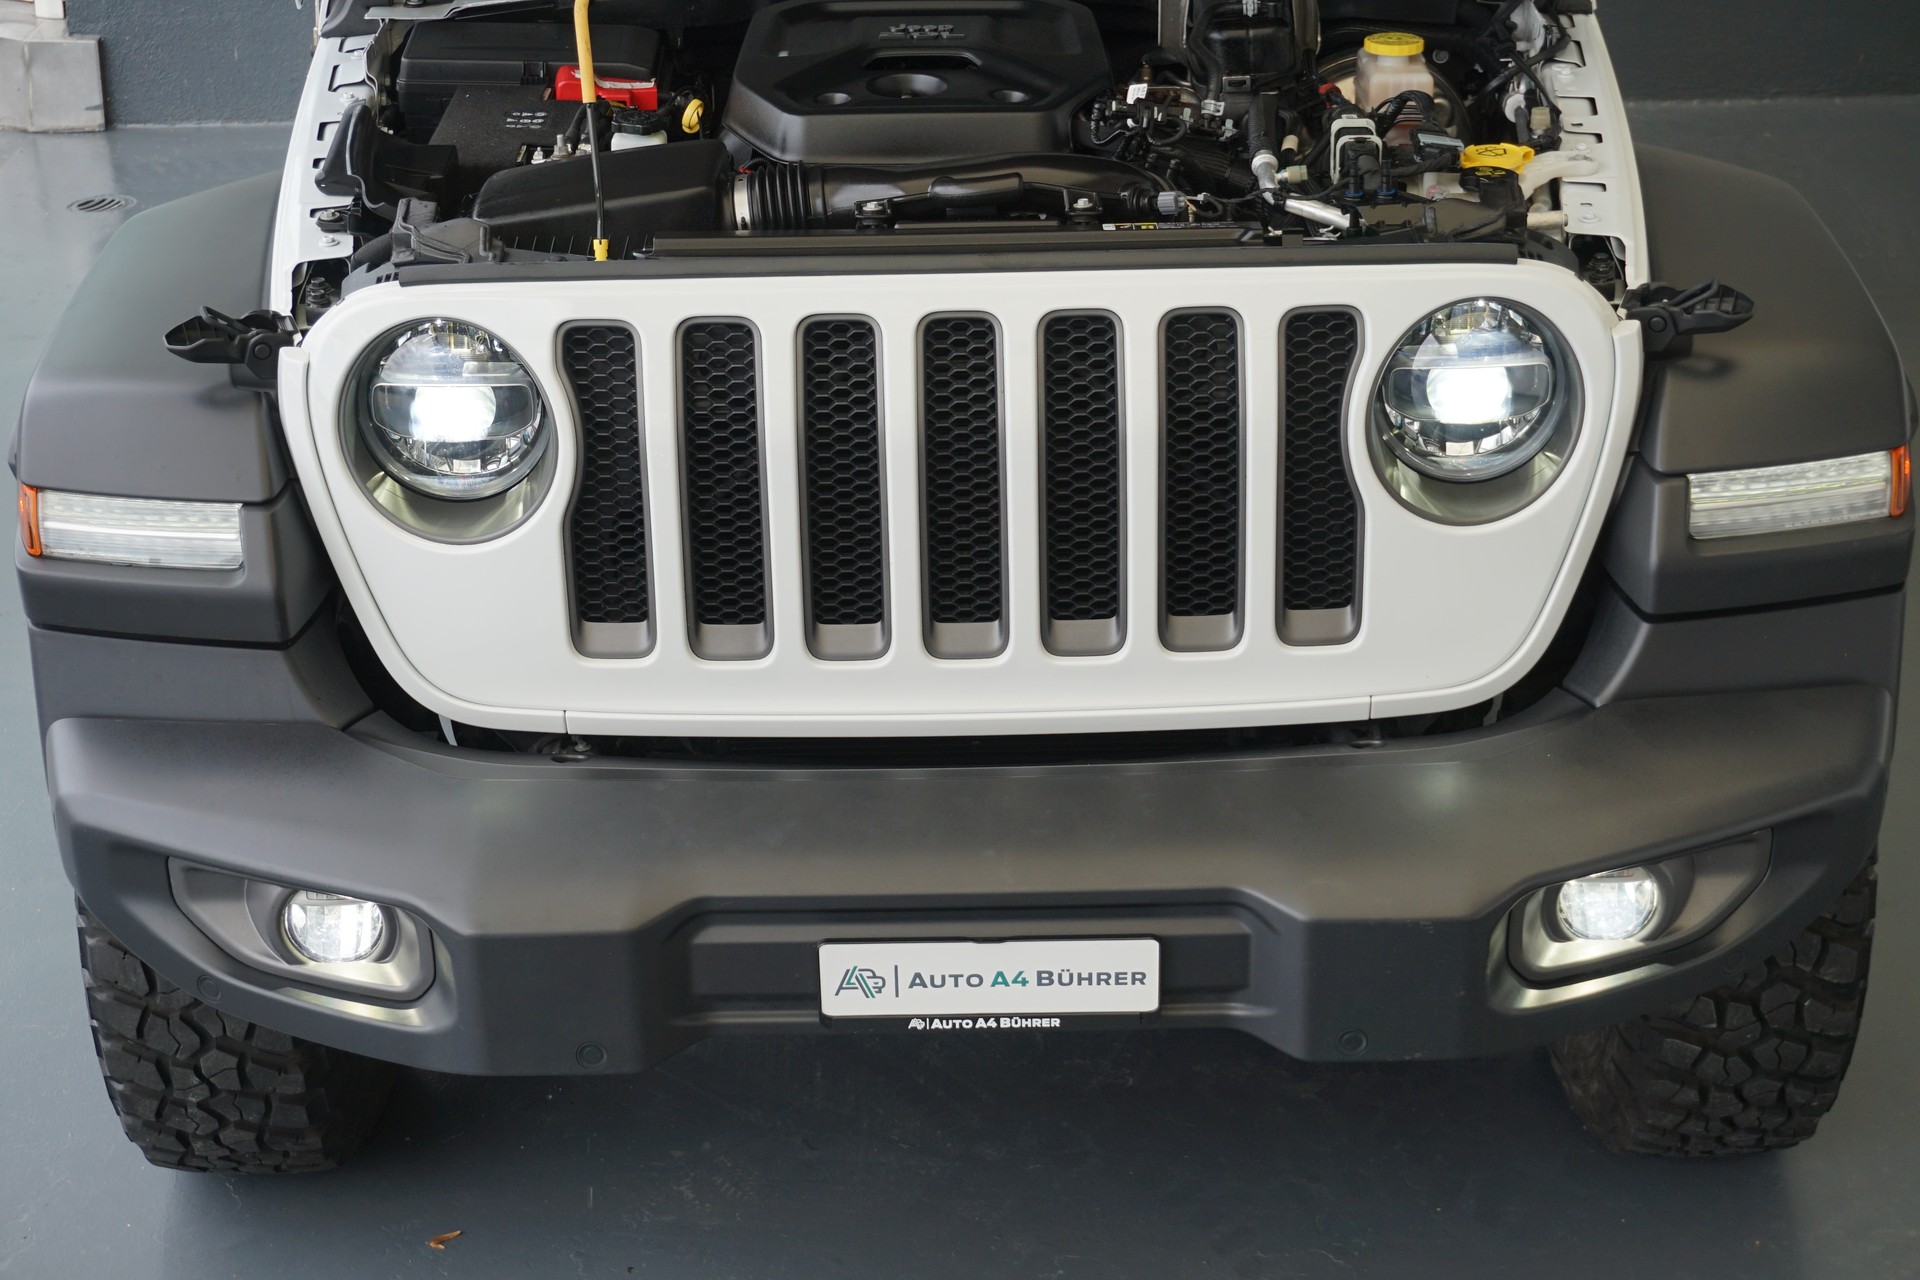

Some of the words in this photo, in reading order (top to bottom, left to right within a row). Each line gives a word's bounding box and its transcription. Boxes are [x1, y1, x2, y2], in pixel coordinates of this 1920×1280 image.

[908, 971, 984, 989] AUTO
[990, 970, 1029, 988] A4
[1036, 968, 1147, 987] BÜHRER
[930, 1018, 973, 1030] AUTO
[975, 1017, 998, 1029] A4
[999, 1016, 1061, 1029] BÜHRER
